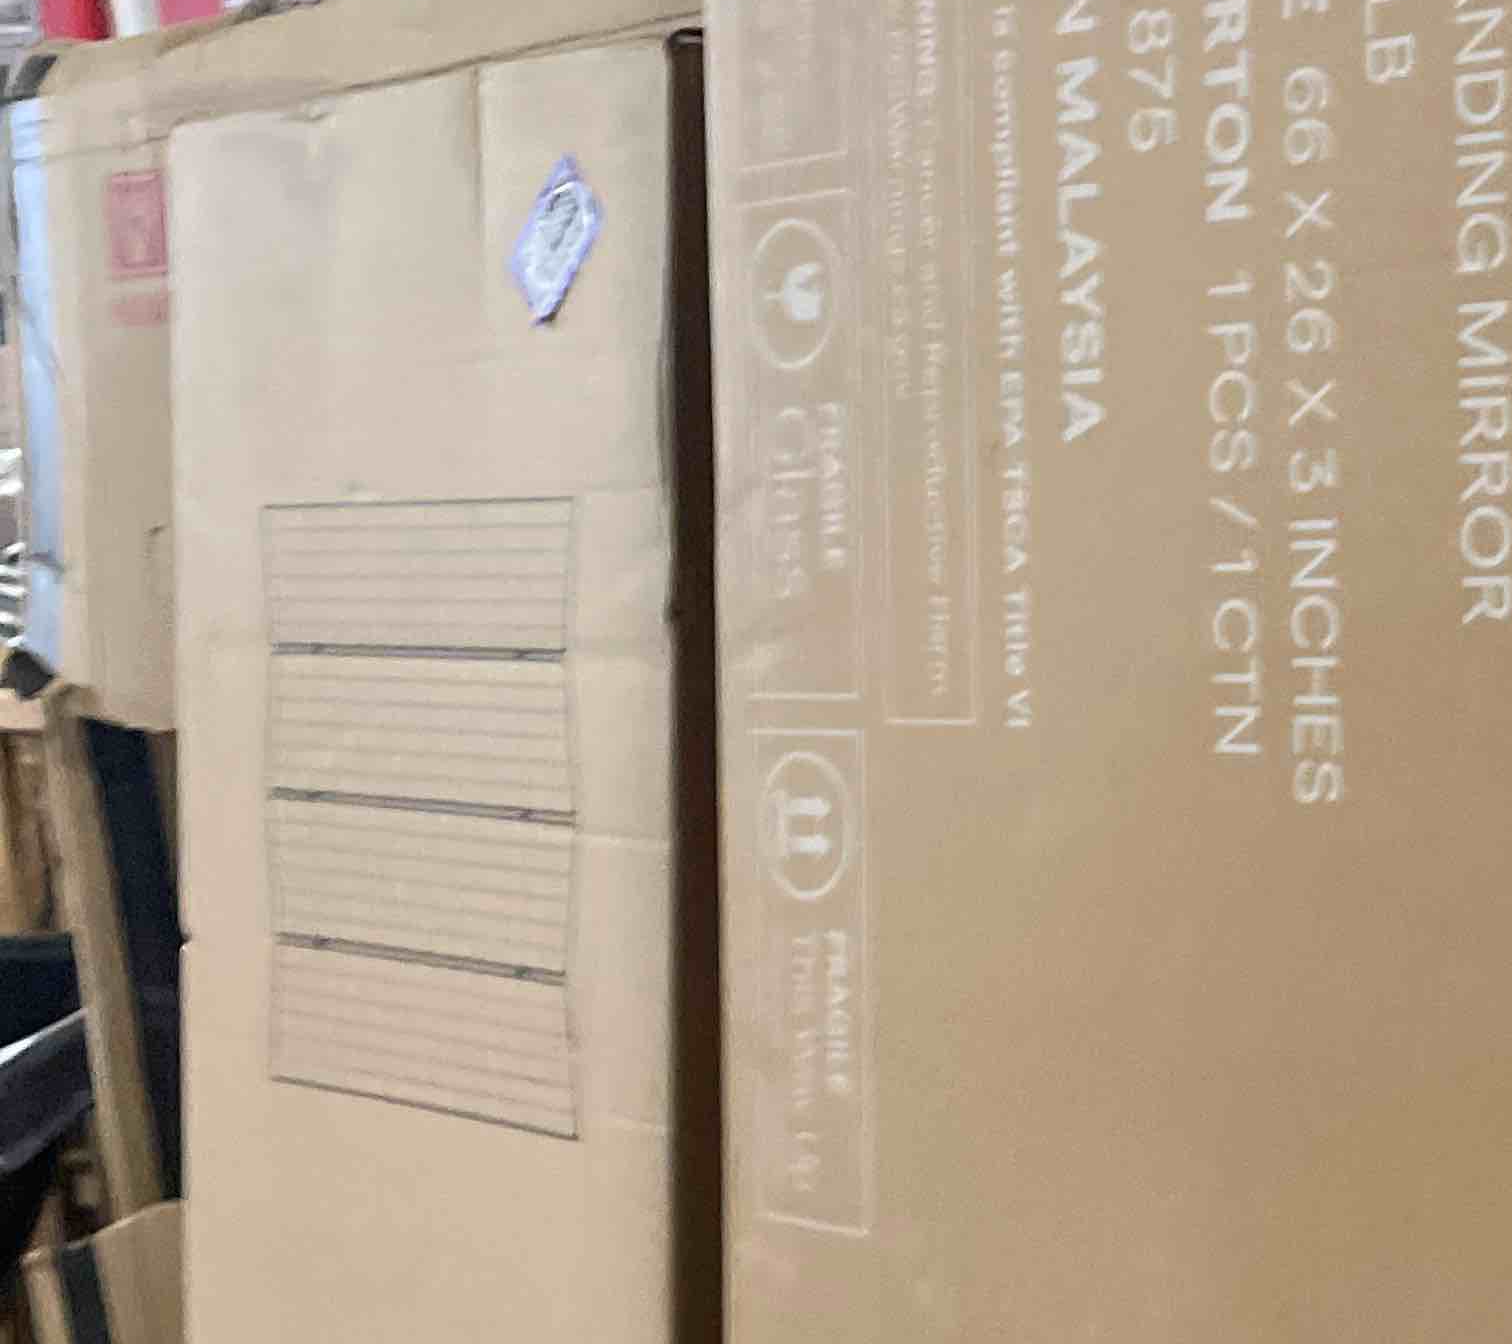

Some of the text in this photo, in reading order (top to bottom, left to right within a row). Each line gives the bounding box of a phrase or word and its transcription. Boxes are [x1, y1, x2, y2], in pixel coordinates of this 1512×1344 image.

[993, 5, 1016, 37] is
[988, 49, 1023, 257] compliant
[1281, 65, 1333, 166] 66
[916, 118, 941, 250] Cancer
[1282, 190, 1338, 239] X
[919, 263, 945, 329] and
[1055, 57, 1107, 442] MALAYSIA
[1206, 268, 1256, 297] 1
[997, 268, 1026, 360] with
[1284, 261, 1339, 356] 26
[1000, 372, 1027, 447] EPA
[1203, 322, 1258, 473] PCS
[1285, 377, 1339, 427] X
[771, 407, 814, 601] Glass
[820, 402, 845, 571] FRAGILE
[915, 342, 948, 584] Reproductive
[1287, 449, 1339, 493] 3
[1001, 461, 1031, 574] TSCA
[924, 595, 951, 697] Harm
[1001, 589, 1032, 677] Title
[1209, 598, 1265, 756] CTN
[1288, 517, 1344, 804] INCHES
[1003, 688, 1034, 729] VI
[824, 930, 852, 1095] FRAGILE
